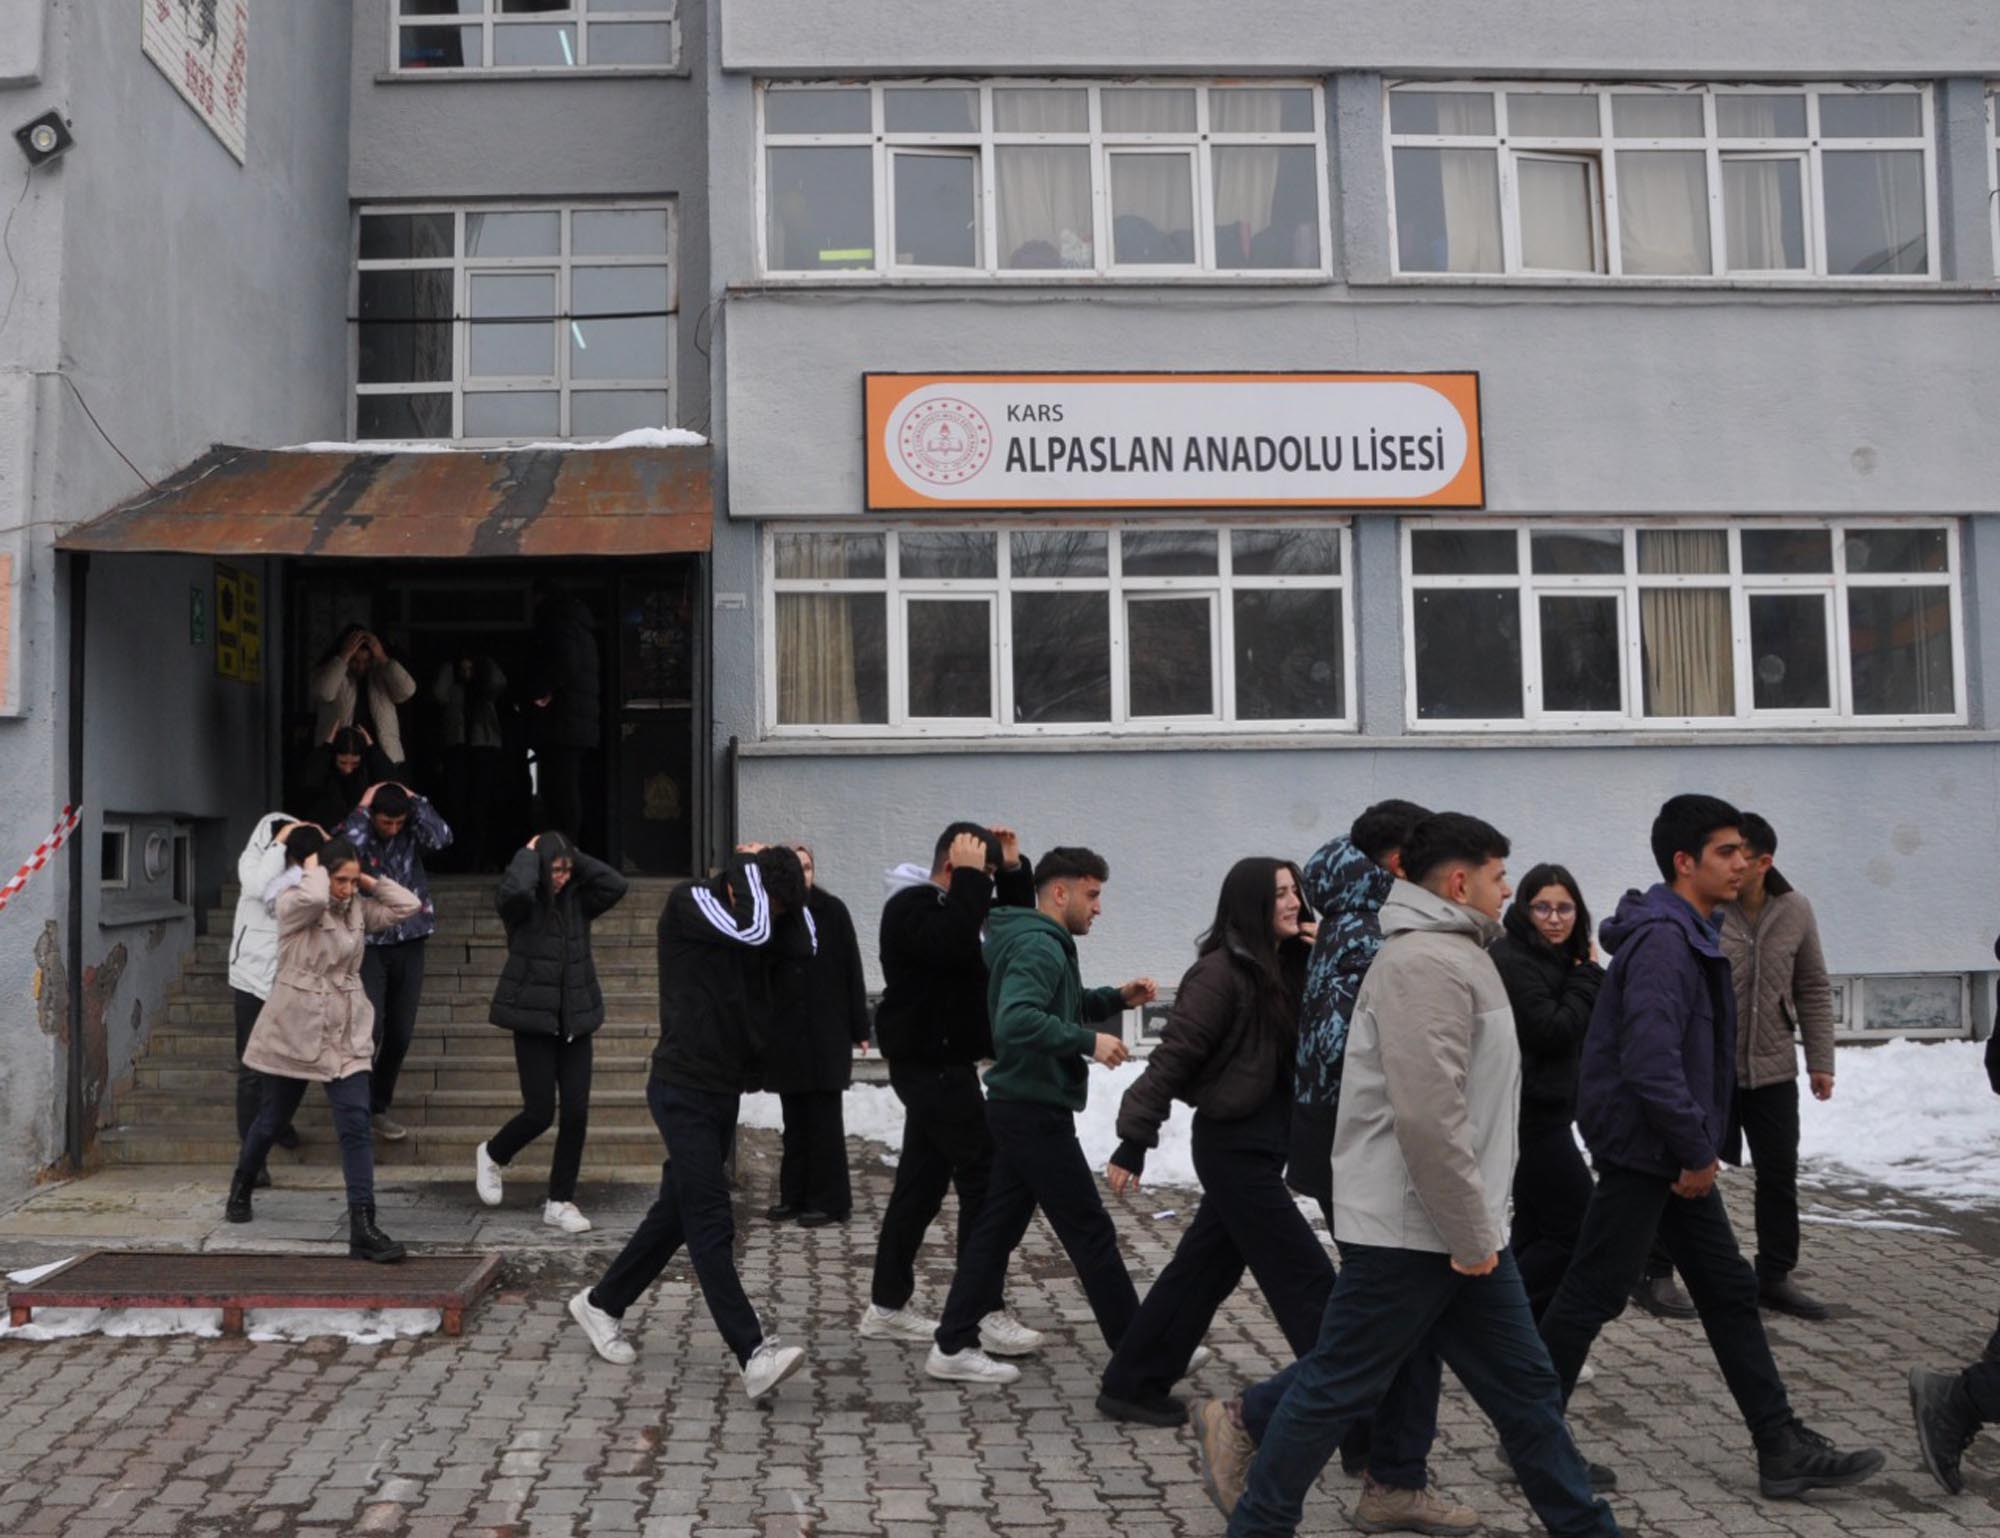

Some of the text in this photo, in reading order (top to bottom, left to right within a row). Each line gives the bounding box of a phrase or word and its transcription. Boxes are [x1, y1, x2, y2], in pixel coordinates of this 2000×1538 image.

[1007, 403, 1064, 422] KARS
[1005, 436, 1174, 473] ALPASLAN
[1183, 435, 1343, 472] ANADOLU
[1352, 427, 1445, 471] LİSESİ
